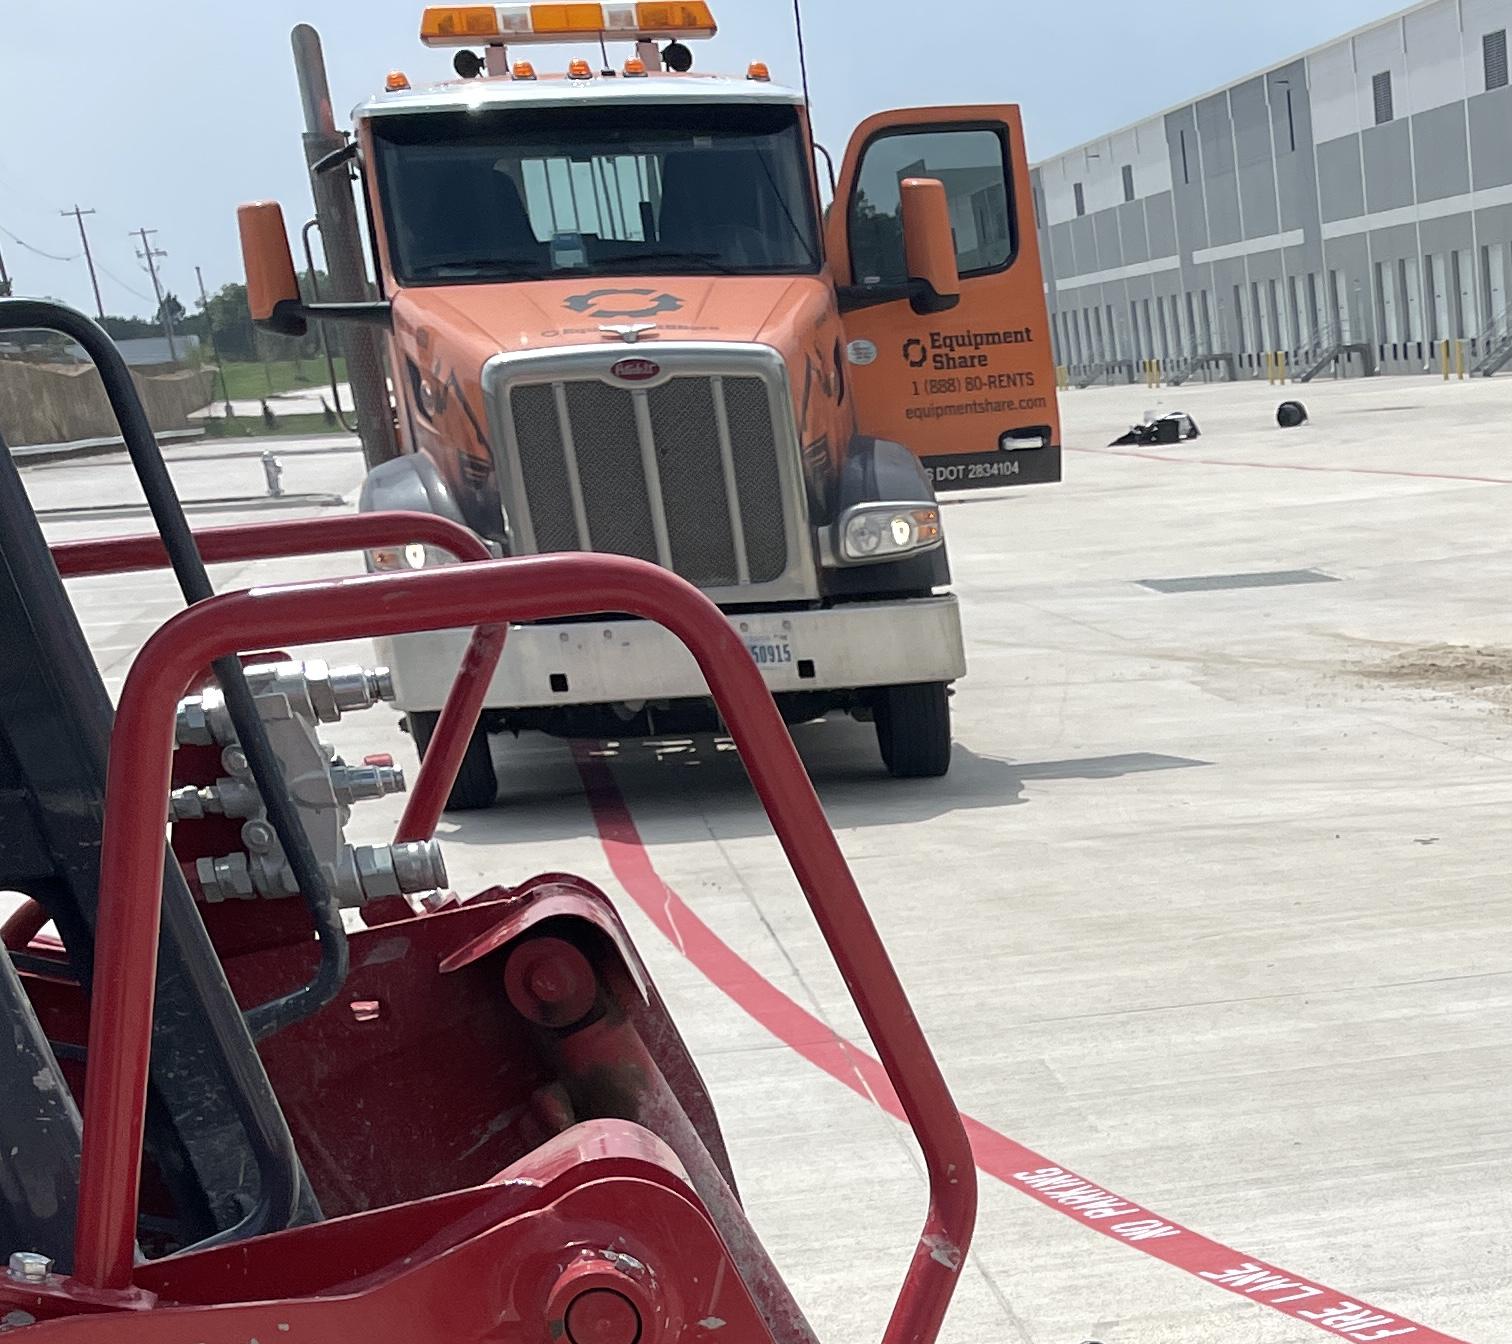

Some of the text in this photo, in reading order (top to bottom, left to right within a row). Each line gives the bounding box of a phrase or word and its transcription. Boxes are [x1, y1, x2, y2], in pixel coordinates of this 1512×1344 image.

[929, 327, 1033, 351] Equipment
[932, 353, 989, 370] Share
[911, 371, 1035, 396] 1 (888) 80-RENTS
[905, 397, 1047, 420] equipmentshare.com
[936, 465, 966, 481] DOT
[968, 461, 1020, 480] 2834104
[1013, 1167, 1417, 1341] FIRE LANE NO PARKING
